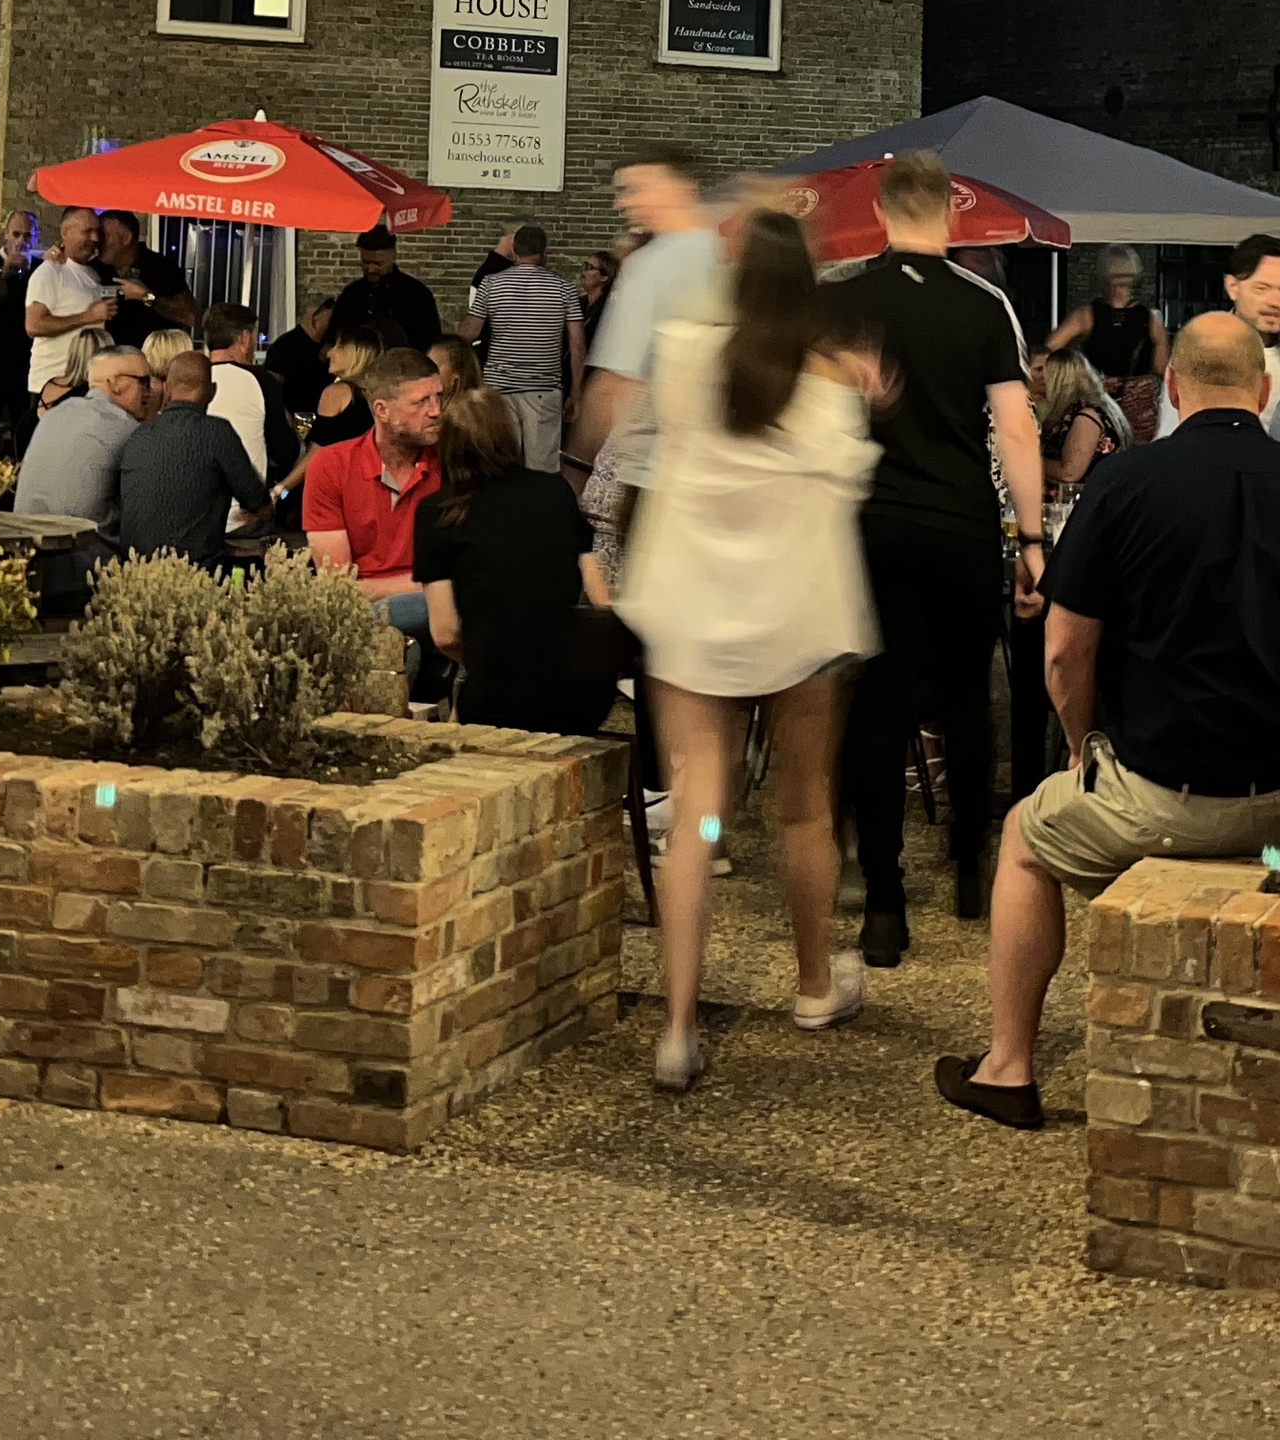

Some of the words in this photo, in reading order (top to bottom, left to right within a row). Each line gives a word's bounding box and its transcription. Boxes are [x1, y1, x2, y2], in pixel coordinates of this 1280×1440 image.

[673, 26, 727, 39] Handmade
[728, 29, 754, 41] Cakes
[453, 34, 547, 54] COBBLES
[705, 42, 735, 54] Scones
[474, 52, 495, 61] TEA
[496, 53, 524, 63] ROOM
[480, 79, 498, 94] the
[453, 83, 541, 114] Rathskeller
[451, 131, 492, 147] 01553
[494, 133, 542, 150] 775678
[447, 148, 545, 166] hansehouse.co.uk
[155, 191, 224, 213] AMSTEL
[230, 199, 276, 219] BIER
